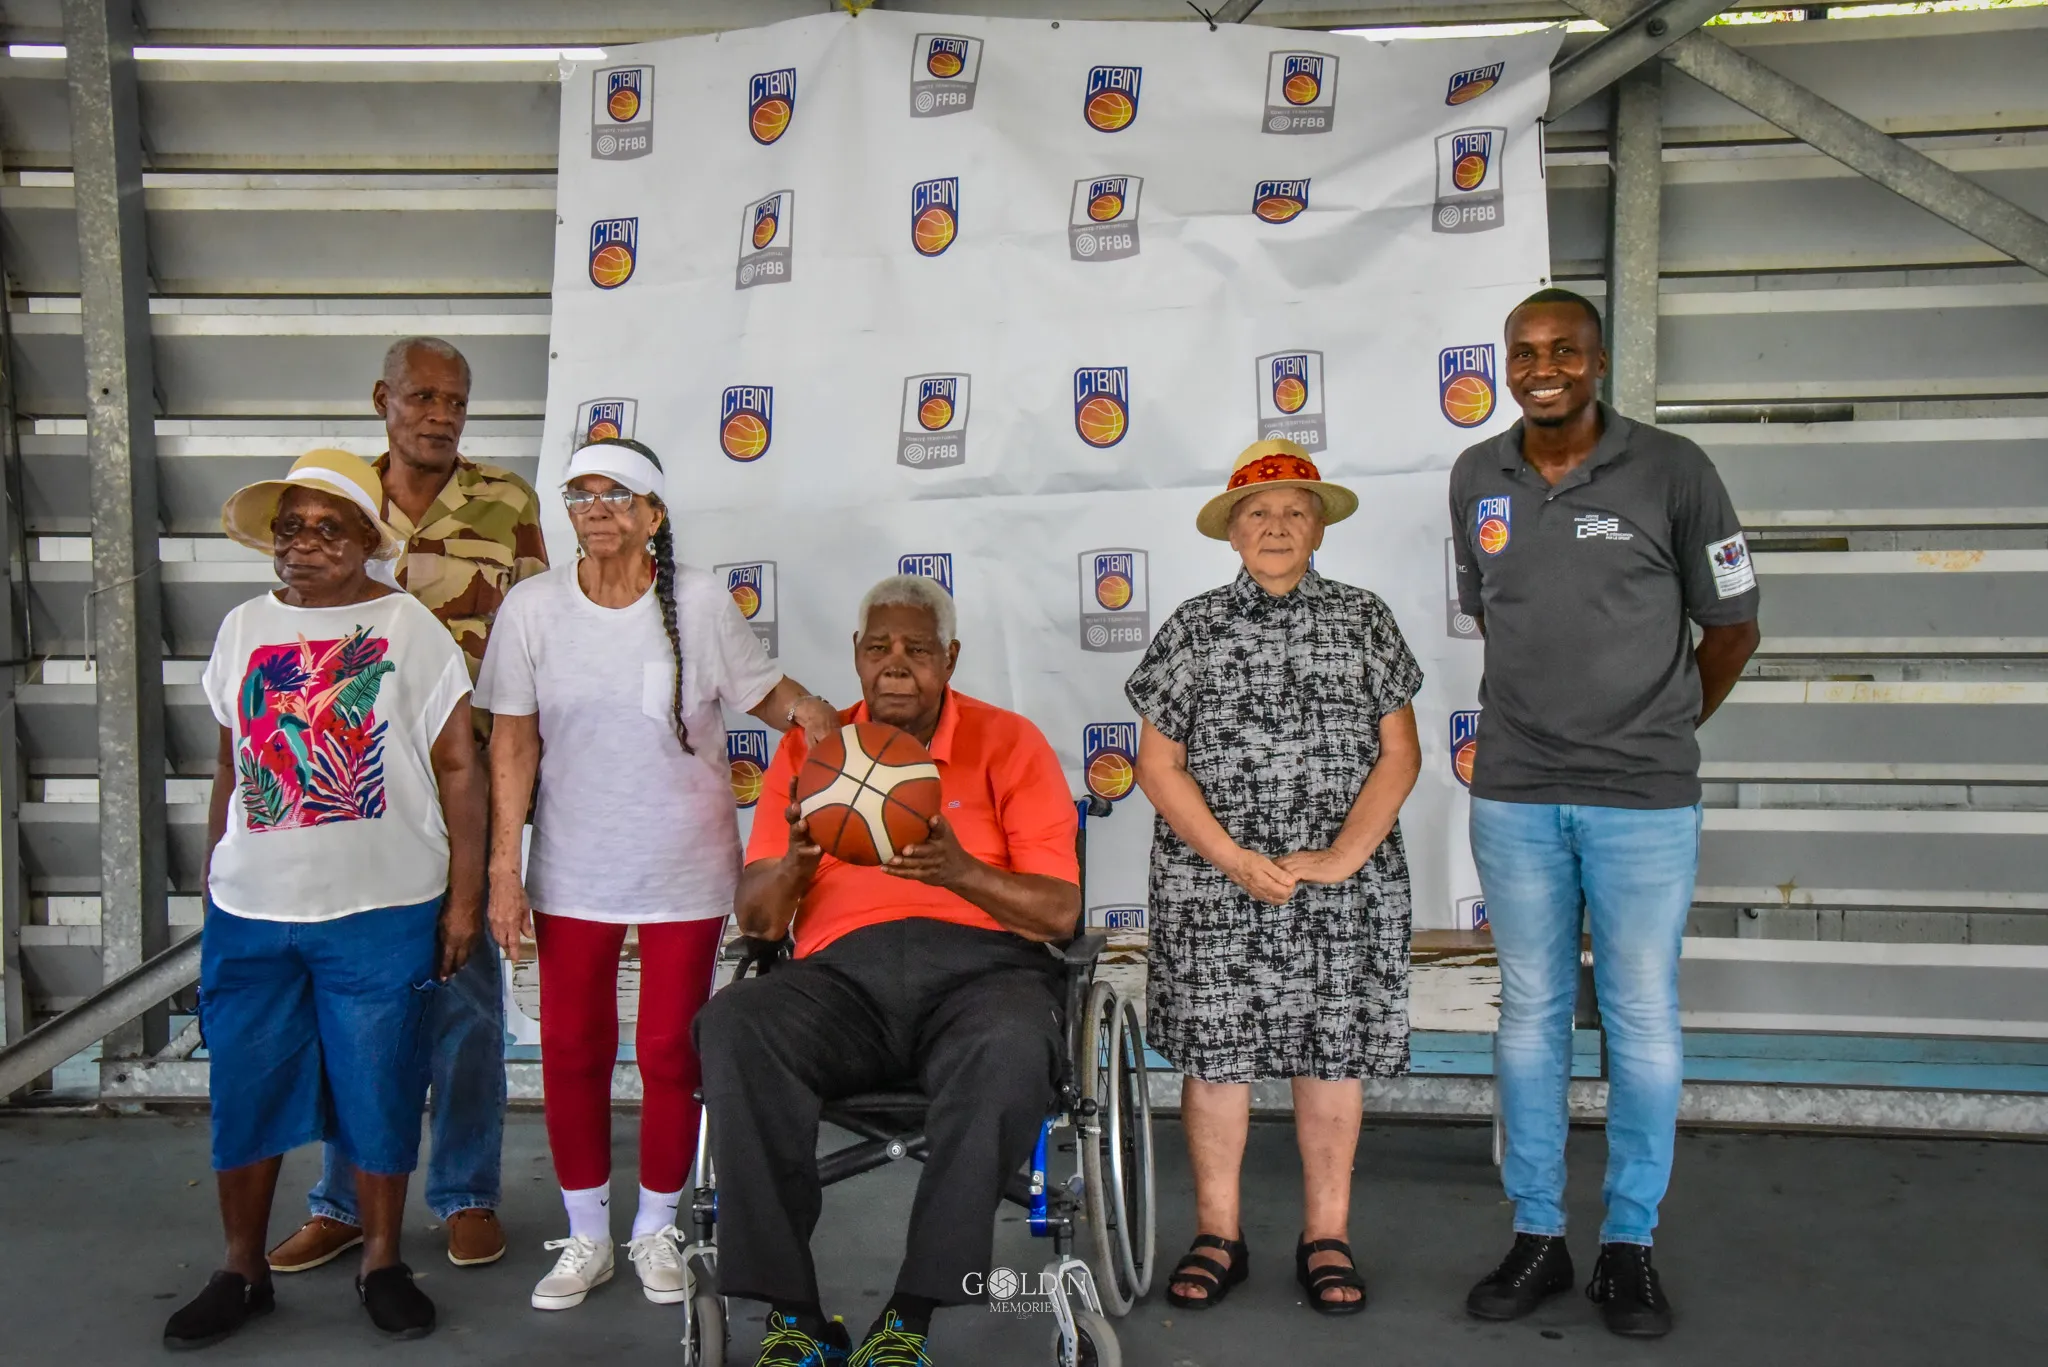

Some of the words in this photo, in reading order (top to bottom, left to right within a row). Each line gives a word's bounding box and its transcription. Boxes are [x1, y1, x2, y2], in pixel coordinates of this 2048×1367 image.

[931, 39, 967, 59] CTBIN
[1285, 57, 1322, 79] CTBIN
[1451, 63, 1504, 91] CTBIN
[609, 70, 640, 94] CTBIN
[751, 70, 794, 106] CTBIN
[1089, 67, 1139, 99] CTBIN
[936, 93, 966, 106] FFBB
[1292, 117, 1325, 128] FFBB
[619, 136, 646, 151] FFBB
[1455, 134, 1490, 161] CTBIN
[914, 179, 957, 216] CTBIN
[1091, 180, 1126, 199] CTBIN
[1257, 179, 1311, 200] CTBIN
[755, 196, 781, 224] CTBIN
[1462, 206, 1496, 222] FFBB
[592, 219, 636, 252] CTBIN
[1099, 235, 1131, 250] FFBB
[755, 262, 783, 276] FFBB
[1273, 357, 1306, 384] CTBIN
[1442, 347, 1492, 383] CTBIN
[920, 380, 955, 402] CTBIN
[1077, 369, 1126, 403] CTBIN
[590, 404, 623, 424] CTBIN
[723, 387, 769, 420] CTBIN
[927, 444, 957, 460] FFBB
[1478, 498, 1510, 525] CTBIN
[729, 568, 761, 588] CTBIN
[1096, 556, 1130, 579] CTBIN
[1111, 627, 1142, 642] FFBB
[725, 733, 766, 760] TBIN
[1086, 725, 1135, 759] CTBIN
